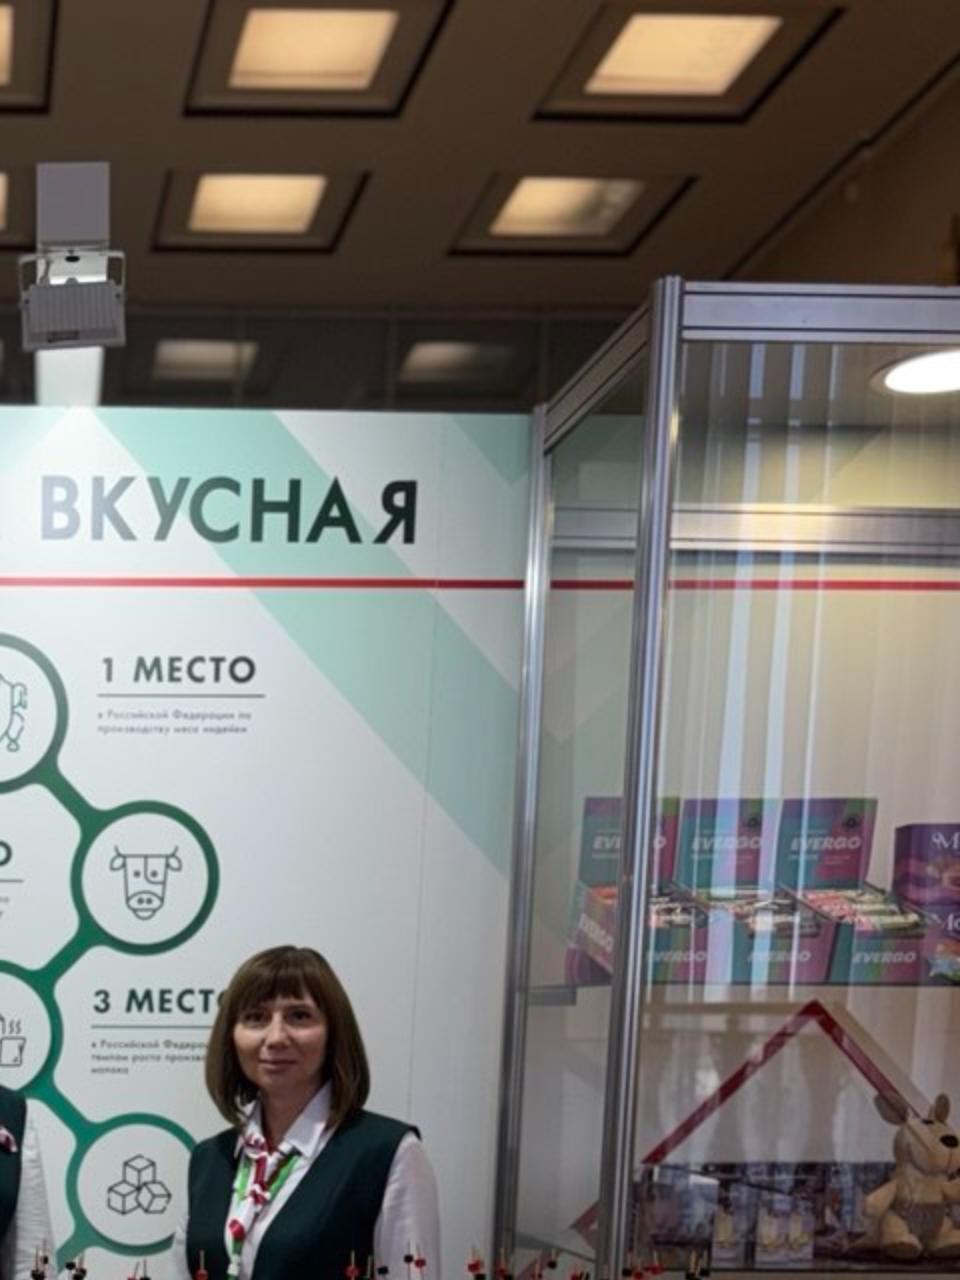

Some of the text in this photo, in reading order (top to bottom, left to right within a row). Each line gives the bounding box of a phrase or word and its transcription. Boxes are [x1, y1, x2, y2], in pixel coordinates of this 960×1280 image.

[41, 473, 419, 545] ВКУСНАЯ
[101, 655, 257, 685] 1 МЕСТО
[691, 835, 762, 851] EVERGO
[789, 836, 862, 852] EVERGO
[852, 949, 917, 965] EVERGO
[93, 988, 112, 1014] 3
